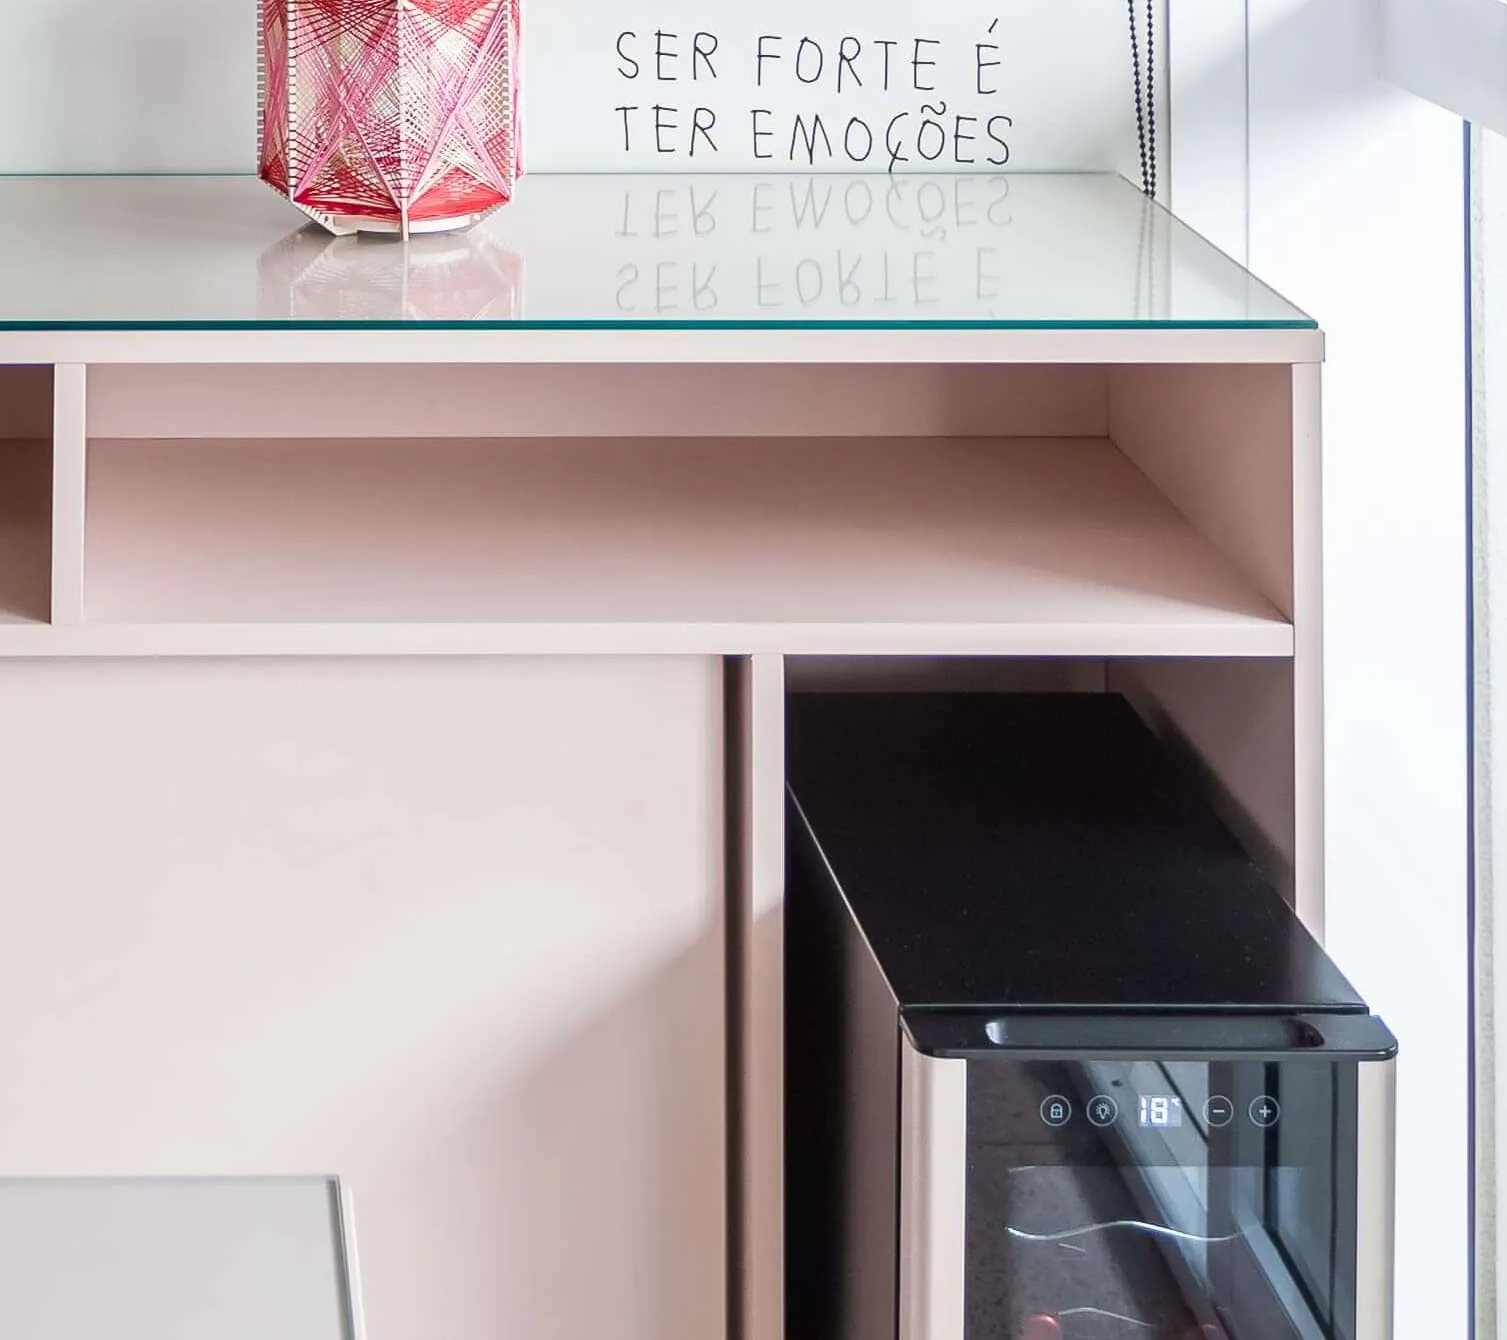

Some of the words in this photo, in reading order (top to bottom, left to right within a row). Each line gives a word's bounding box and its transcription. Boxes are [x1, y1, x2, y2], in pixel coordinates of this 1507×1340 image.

[615, 28, 719, 82] SER
[756, 35, 941, 93] FORTE
[975, 17, 1002, 95] É
[614, 104, 719, 158] TER
[750, 100, 1013, 174] EMOÇÕES
